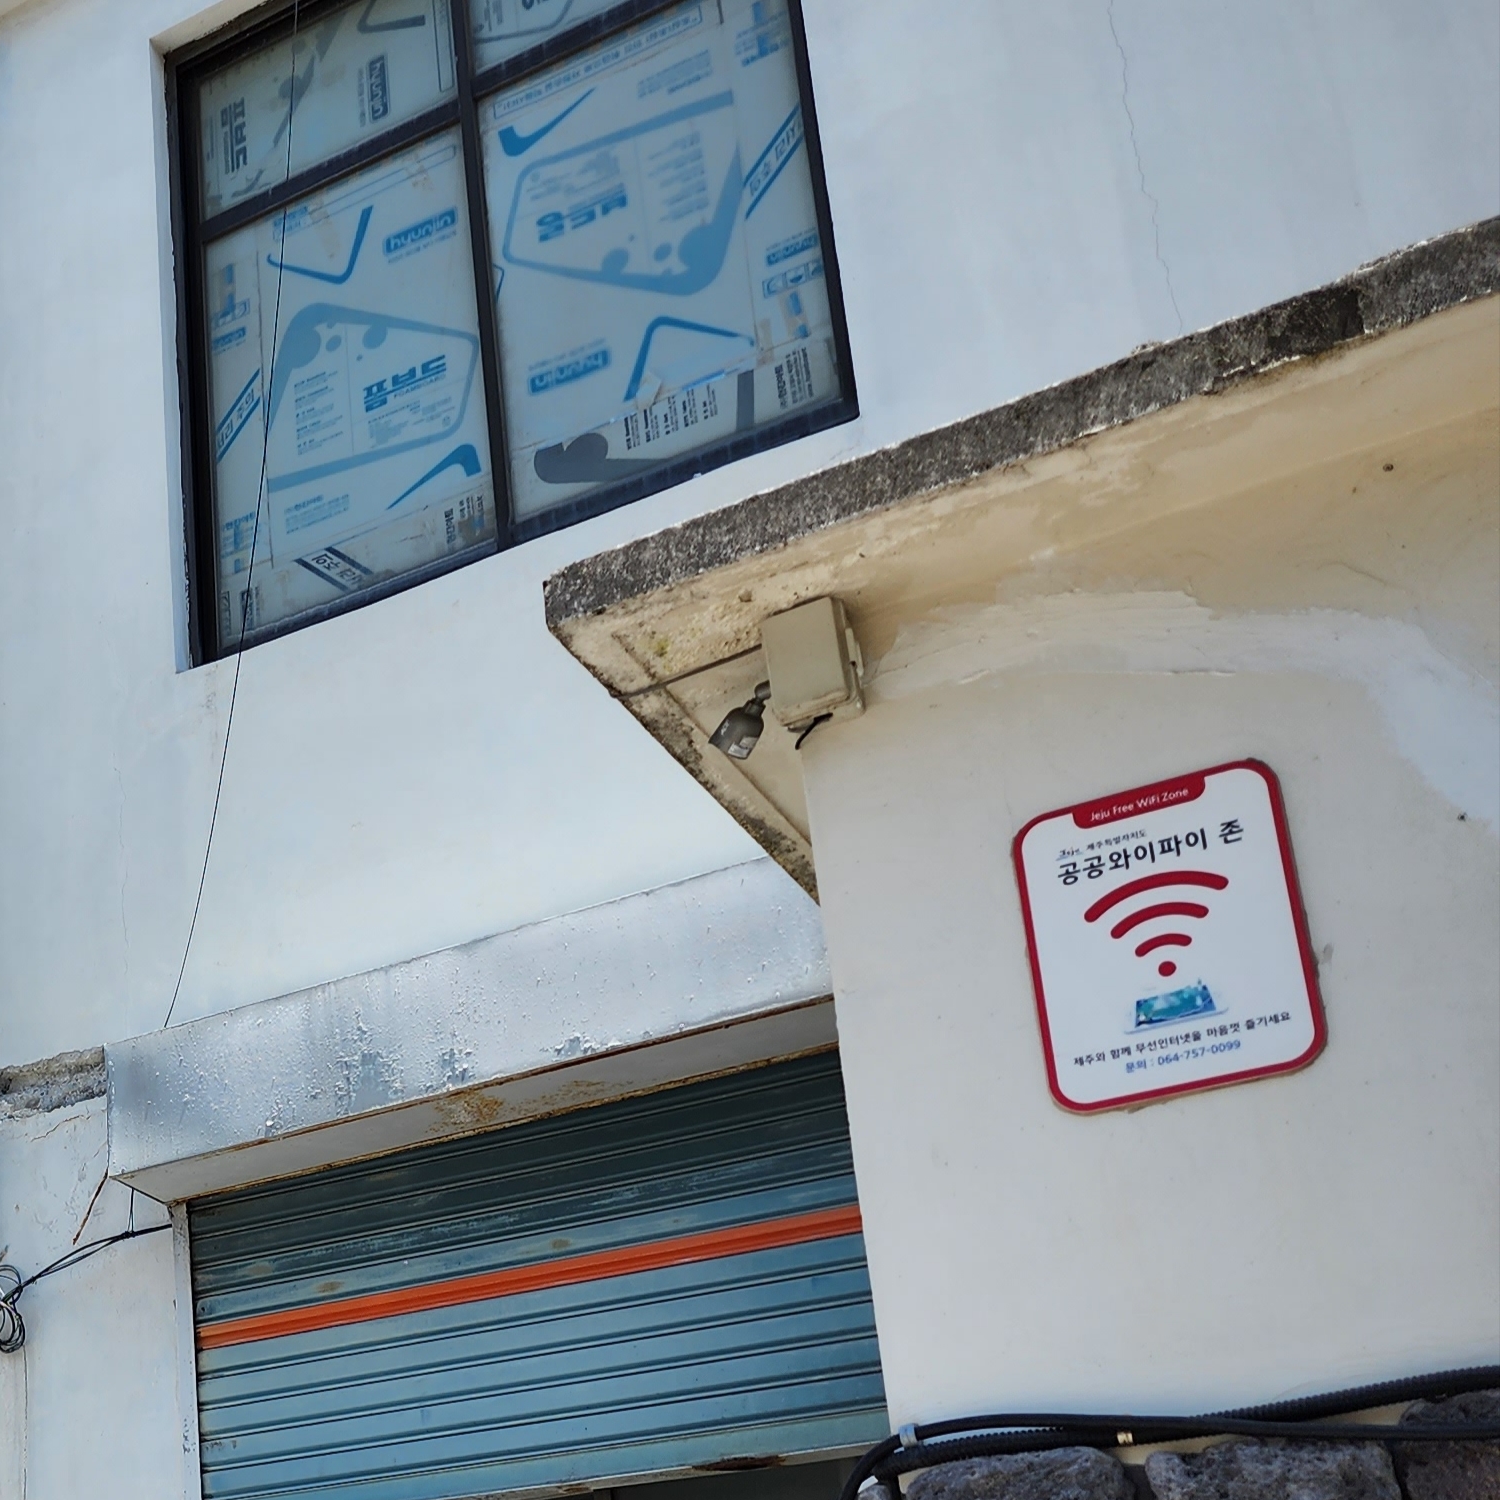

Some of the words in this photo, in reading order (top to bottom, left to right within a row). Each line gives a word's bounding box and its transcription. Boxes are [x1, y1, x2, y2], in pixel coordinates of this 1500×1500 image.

[389, 211, 454, 252] hyunjin
[363, 355, 447, 412] 폼보드
[1089, 809, 1111, 822] Jeju
[1112, 803, 1134, 816] Free
[1135, 795, 1160, 809] WiFi
[1161, 786, 1189, 803] Zone
[1057, 827, 1208, 886] 공공와이파이
[1218, 818, 1245, 845] 존
[1073, 1050, 1106, 1068] 제주와
[1110, 1046, 1132, 1060] 함께
[1135, 1030, 1202, 1054] 무선인터넷을
[1244, 1011, 1292, 1031] 즐기세요
[1125, 1059, 1147, 1074] 문의
[1157, 1039, 1242, 1066] 064-757-0099
